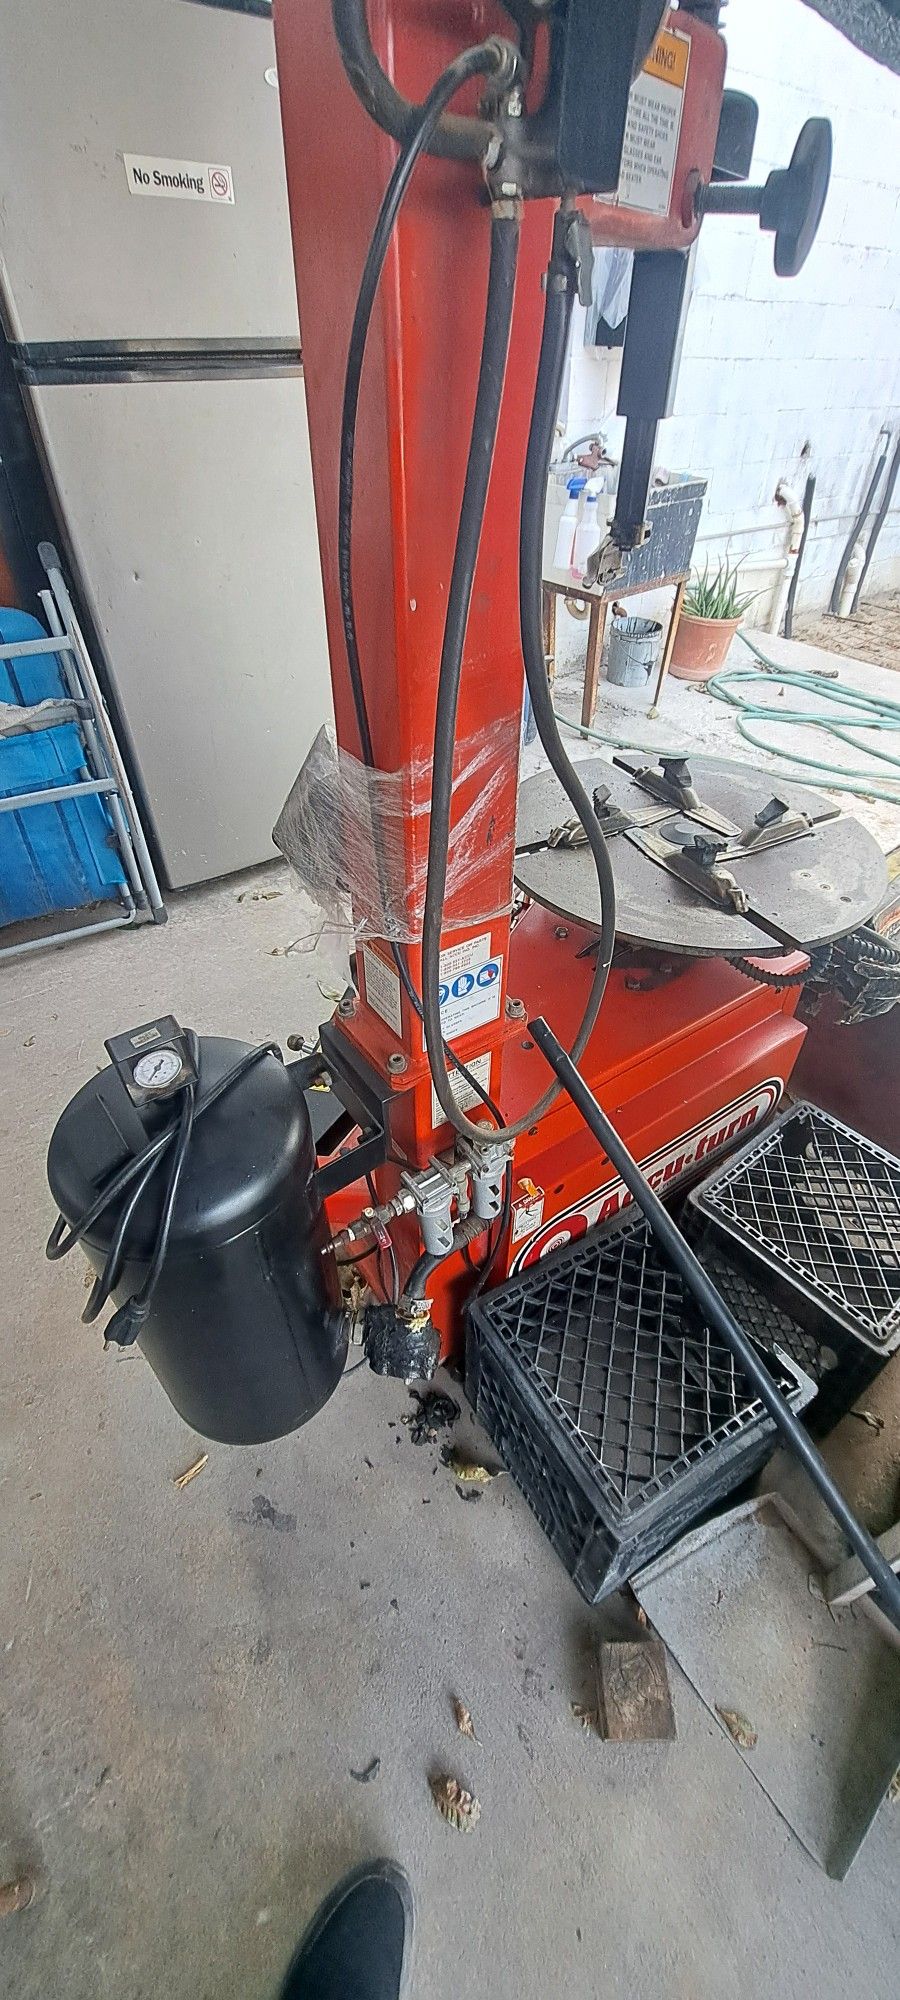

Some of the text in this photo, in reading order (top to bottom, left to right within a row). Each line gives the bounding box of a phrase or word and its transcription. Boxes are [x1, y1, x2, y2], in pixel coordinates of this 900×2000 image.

[652, 46, 677, 71] NING!
[132, 167, 205, 194] No Smoking
